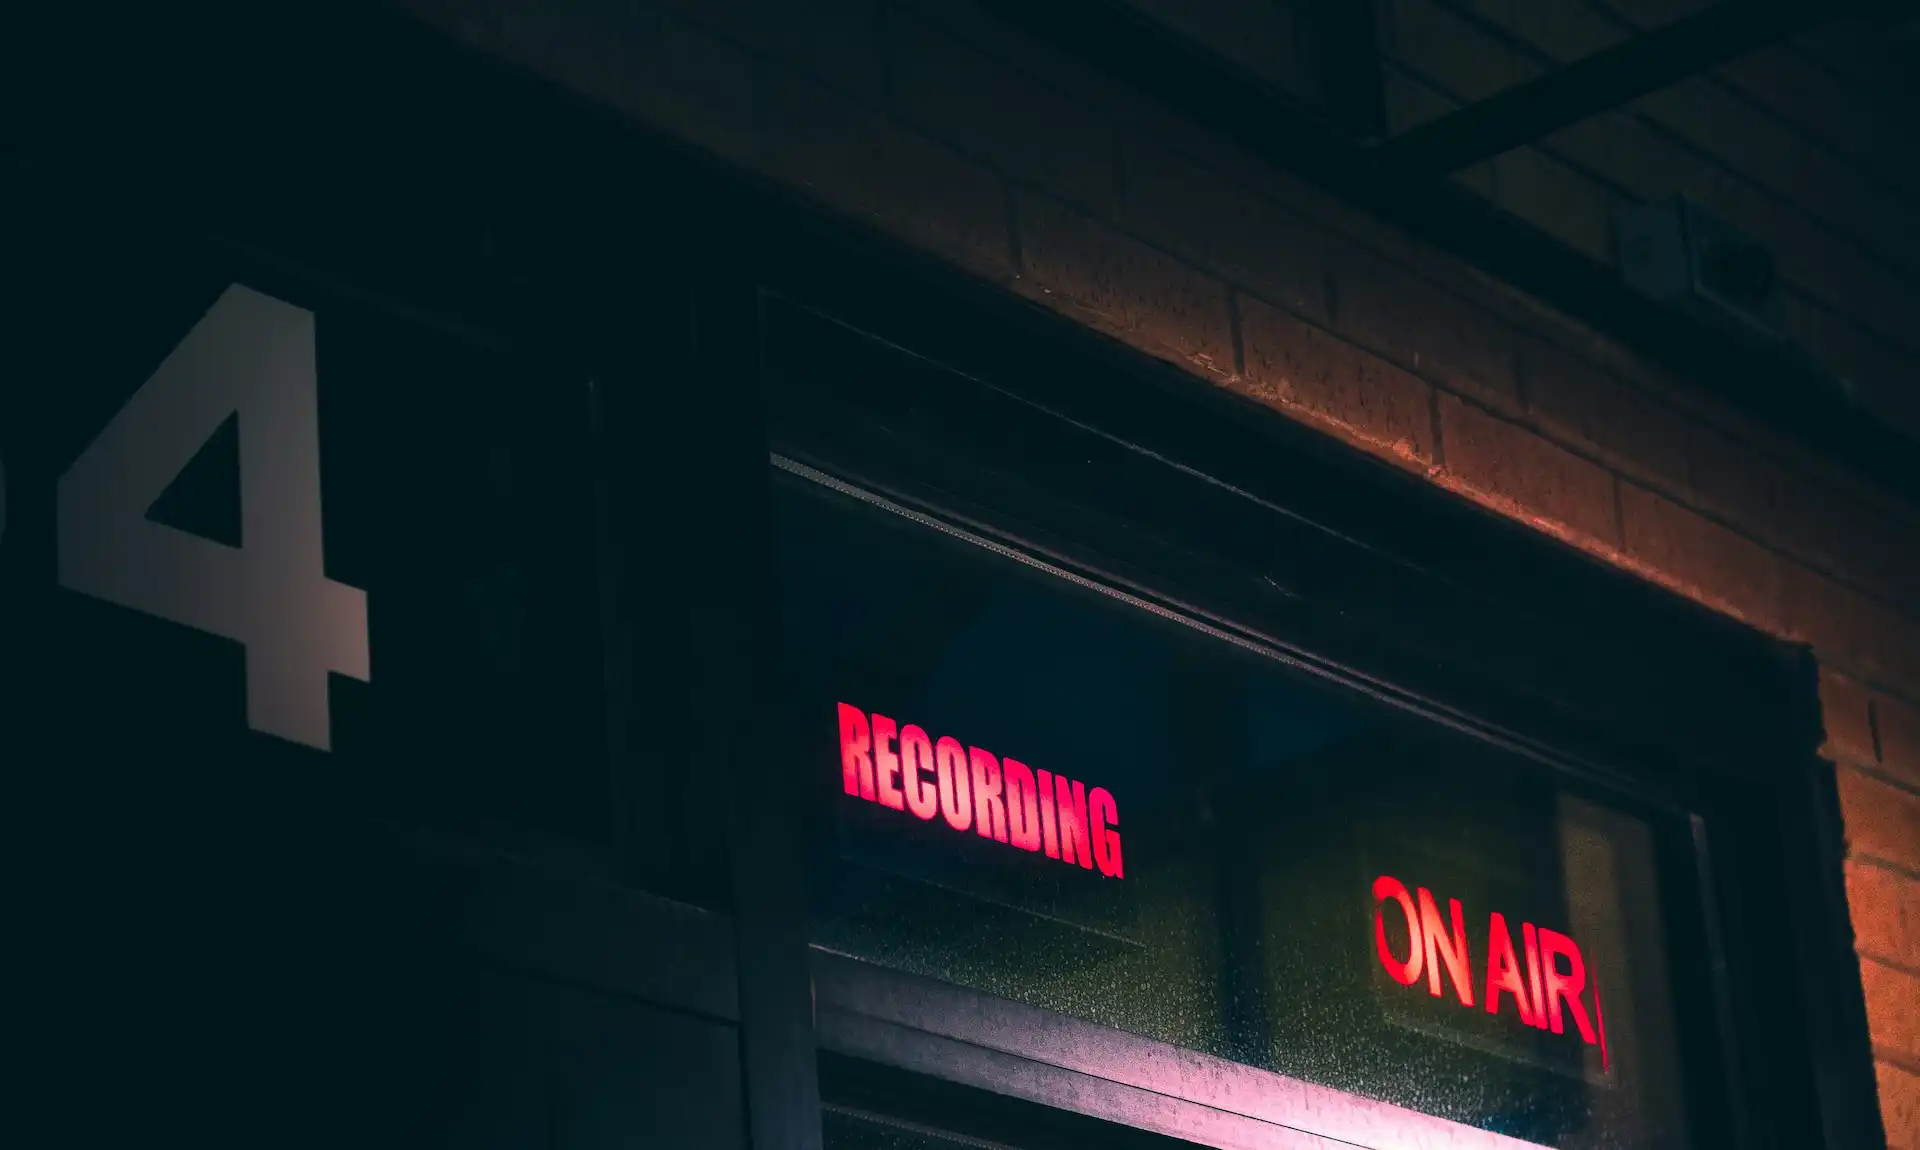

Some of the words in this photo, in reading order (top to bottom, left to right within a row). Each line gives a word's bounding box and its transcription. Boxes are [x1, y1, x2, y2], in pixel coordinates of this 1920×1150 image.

[0, 281, 371, 753] 4
[837, 702, 1124, 880] RECORDING
[1372, 875, 1475, 1008] ON
[1485, 911, 1597, 1046] AIR
